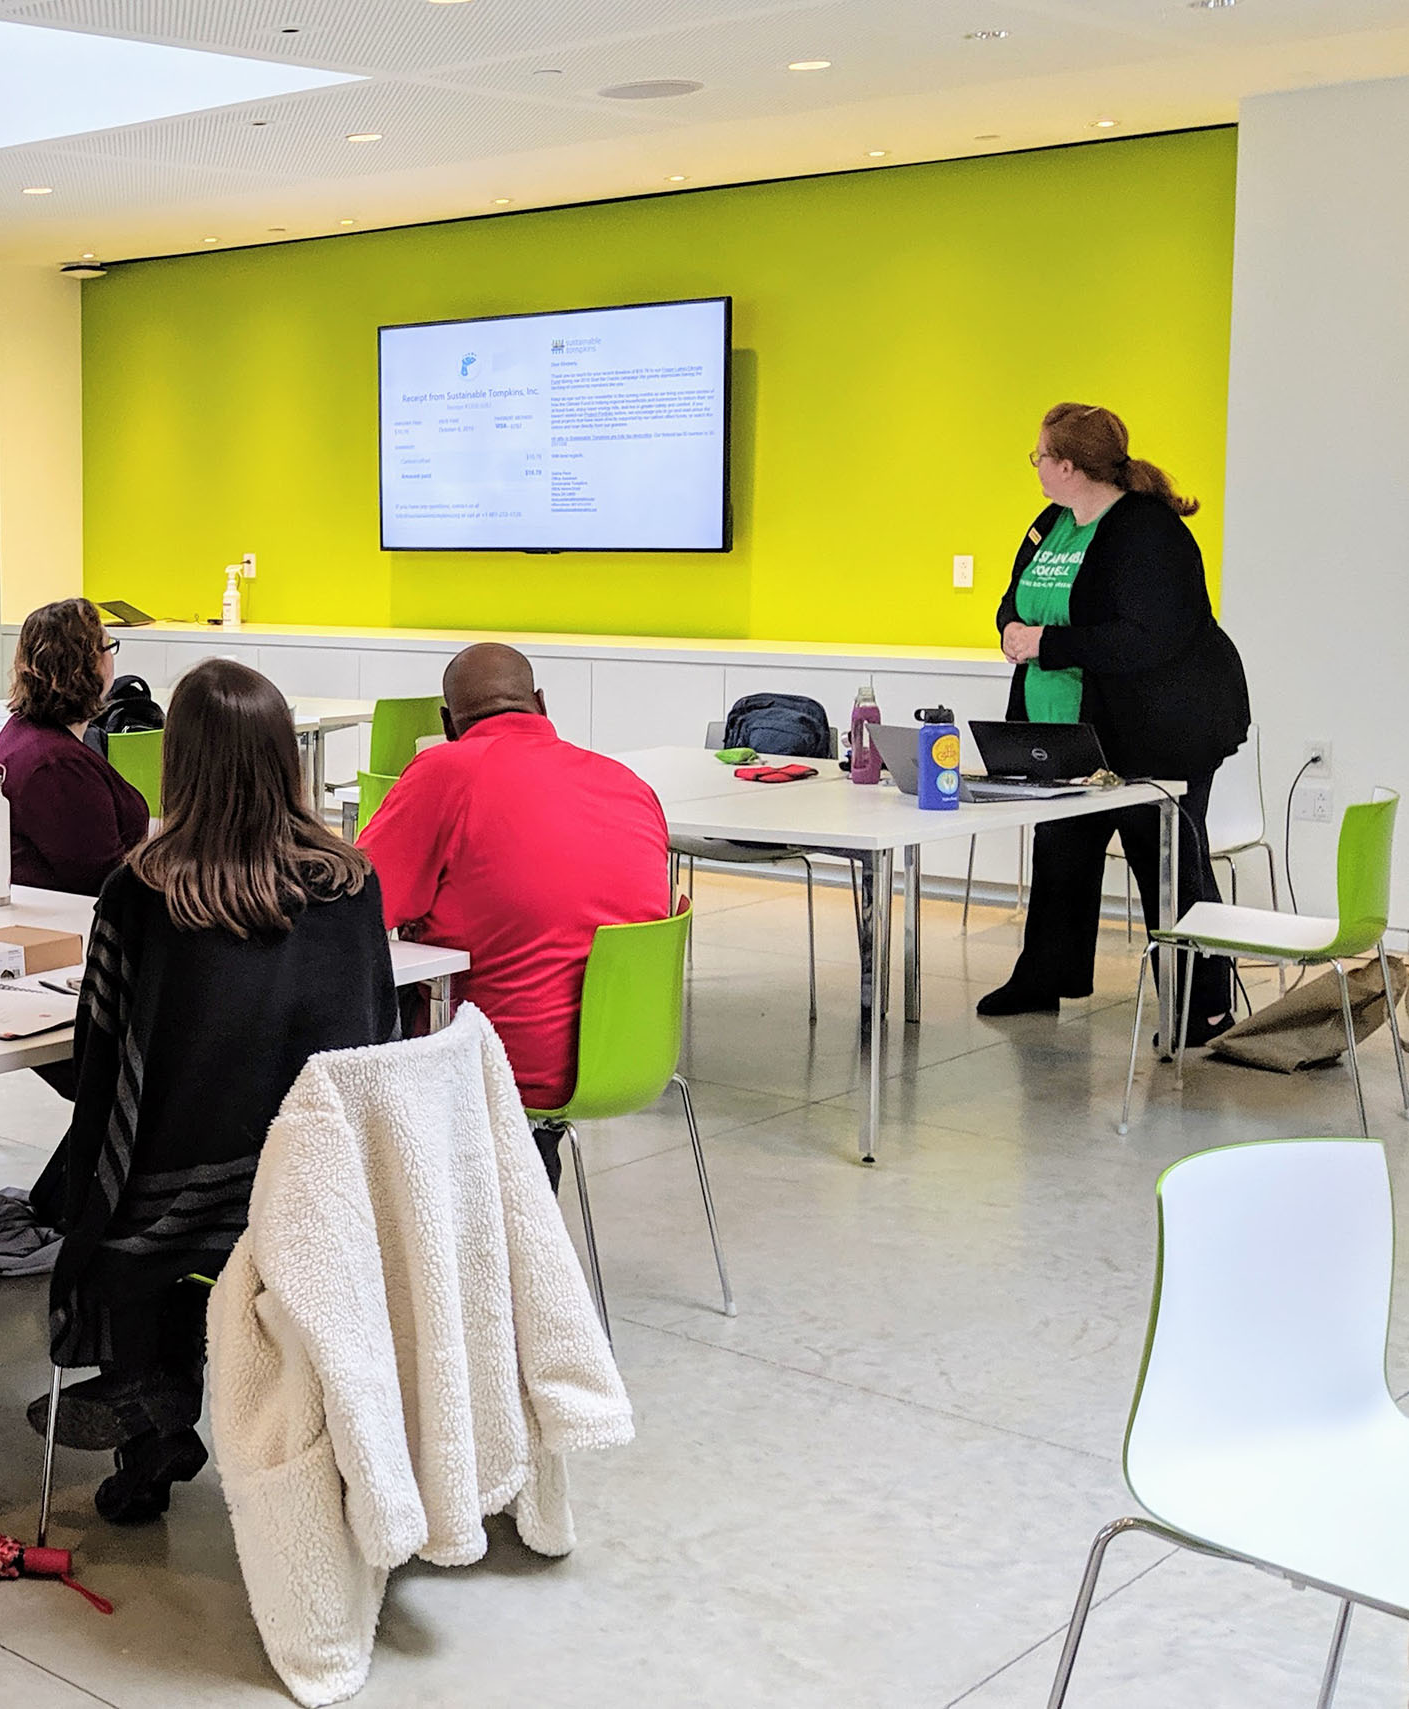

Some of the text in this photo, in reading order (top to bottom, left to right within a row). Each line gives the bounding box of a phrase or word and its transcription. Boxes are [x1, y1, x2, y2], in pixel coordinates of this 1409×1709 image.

[402, 393, 428, 404] Receipt
[429, 392, 445, 401] from
[447, 390, 487, 401] Sustainable
